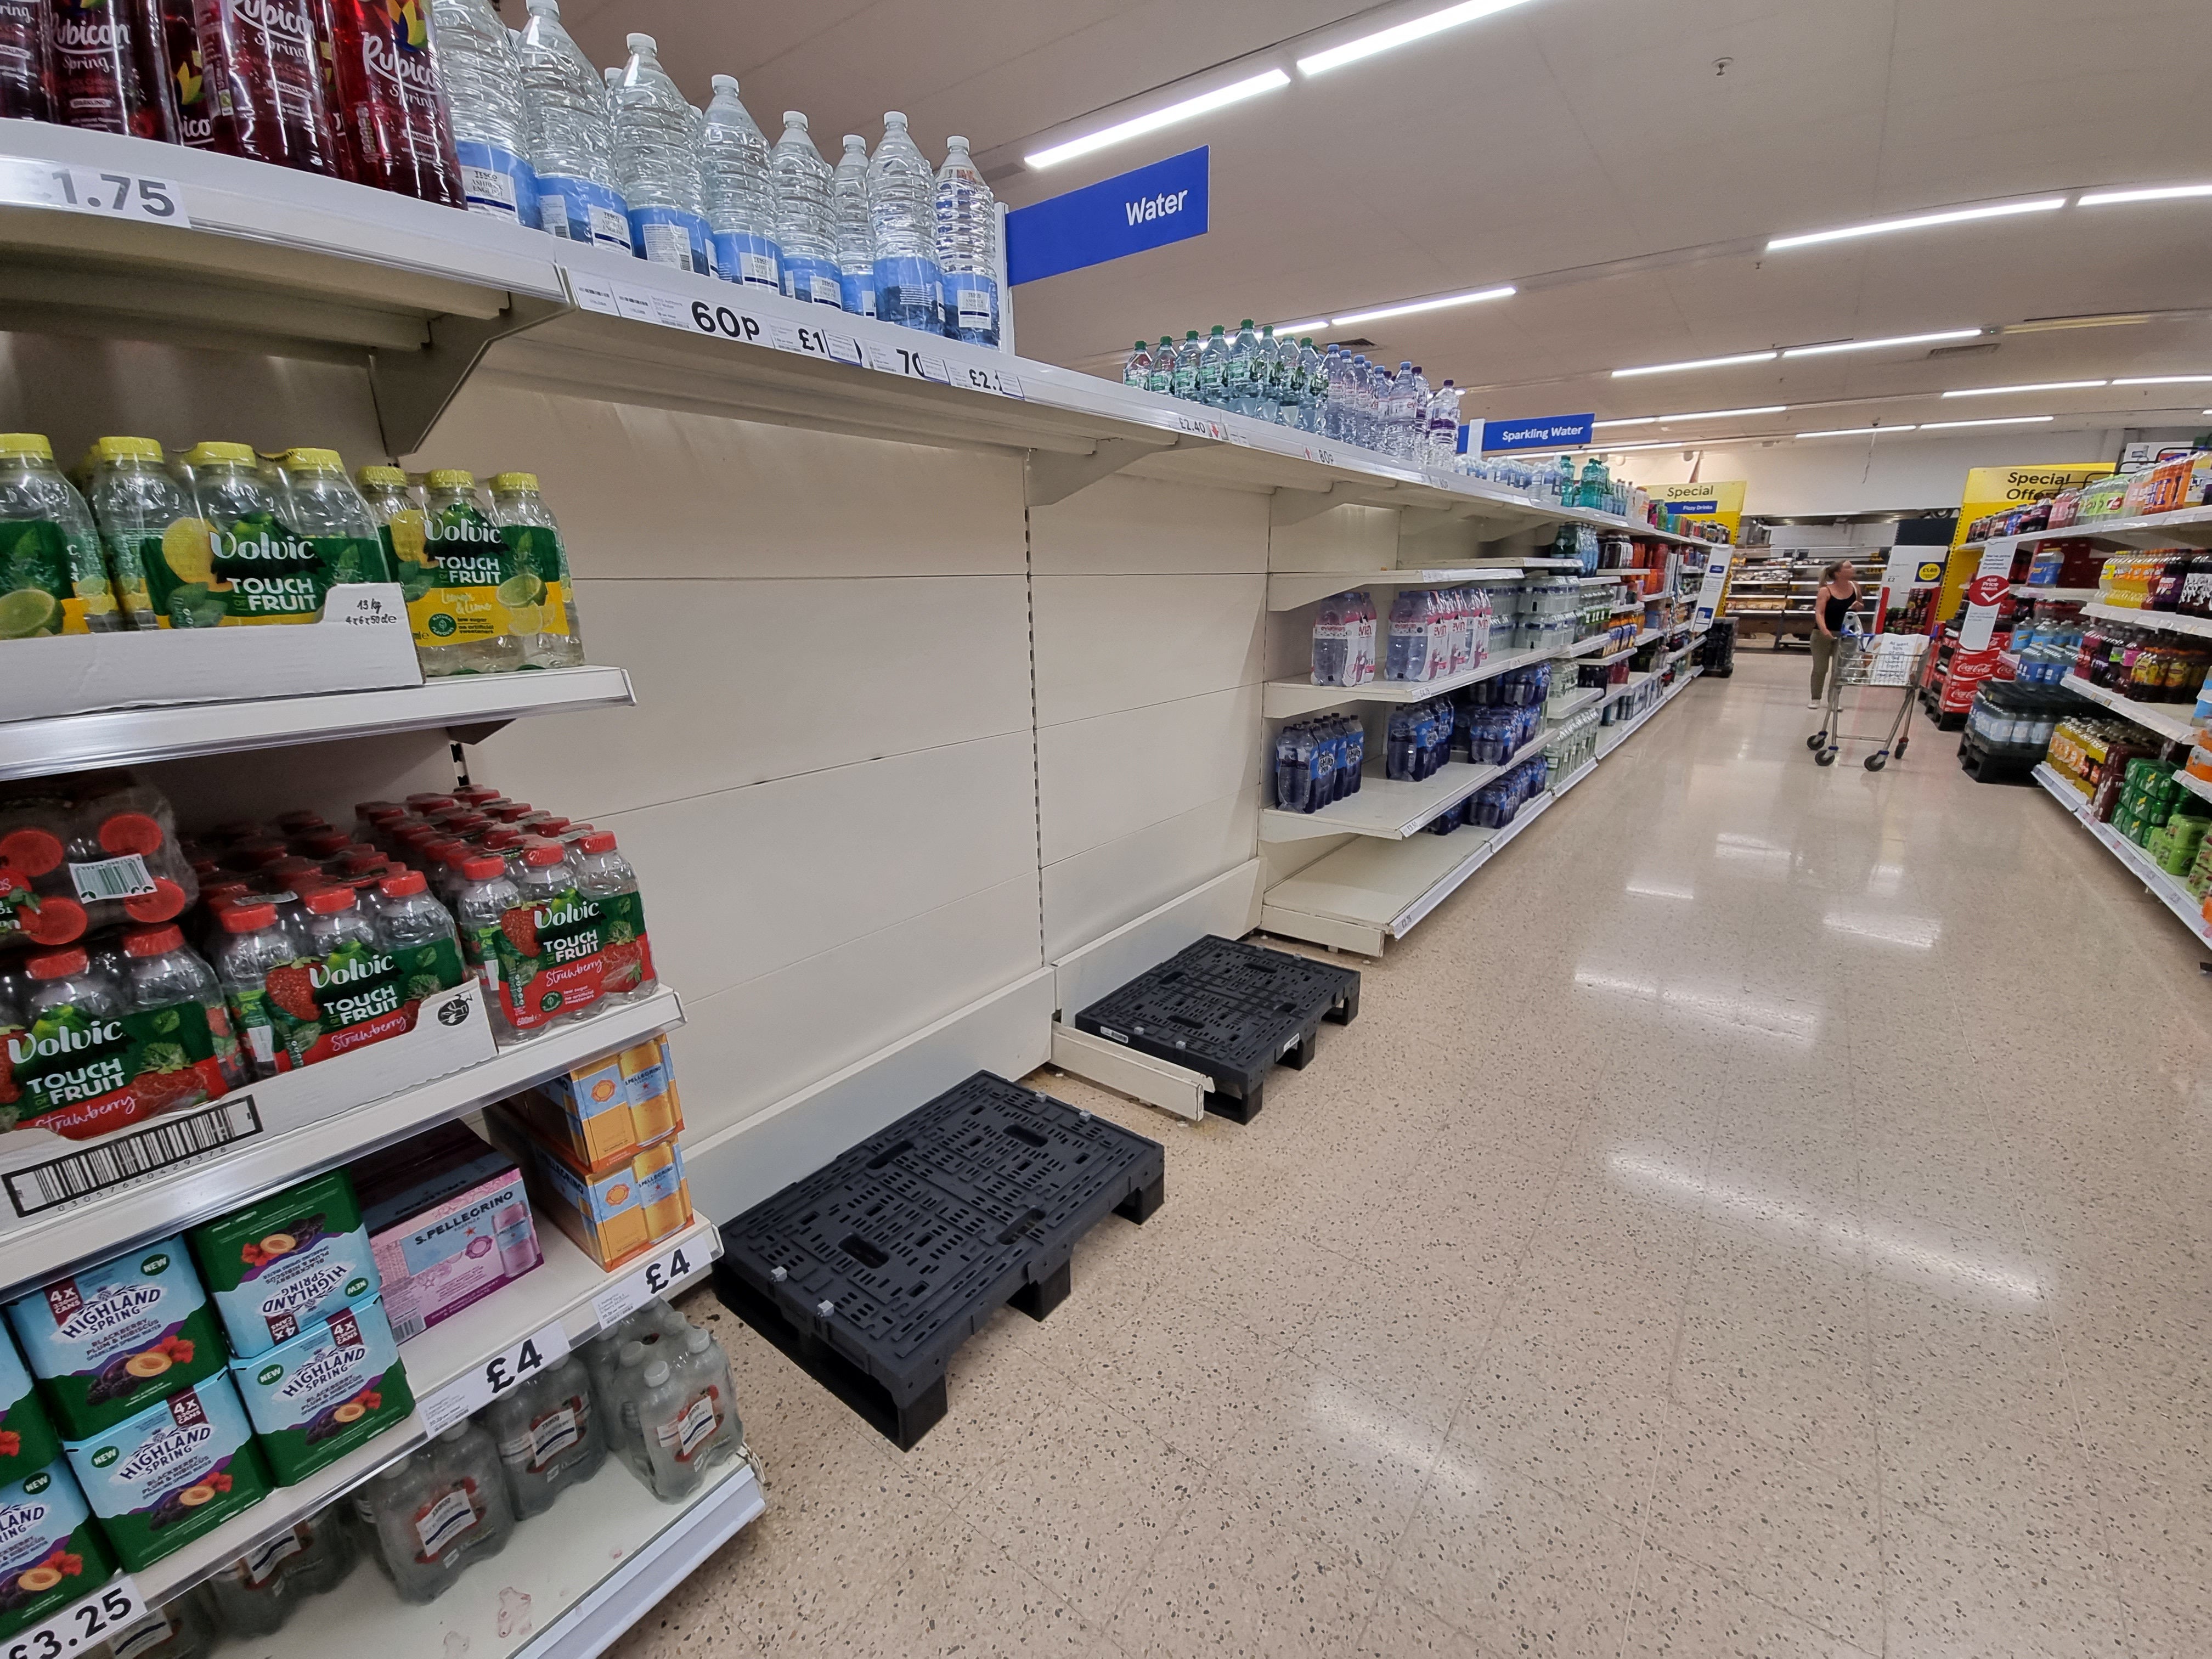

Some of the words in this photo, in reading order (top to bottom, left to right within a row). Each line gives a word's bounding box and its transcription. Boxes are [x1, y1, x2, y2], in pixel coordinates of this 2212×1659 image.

[55, 13, 131, 49] ubicon
[63, 56, 110, 75] Spring
[474, 170, 498, 182] TESCO
[33, 167, 175, 217] 1.75
[1126, 190, 1188, 226] Water
[691, 301, 760, 341] 60p
[1179, 417, 1206, 434] £2.40
[1502, 429, 1549, 443] Sparkling
[1551, 426, 1584, 437] Water
[1319, 449, 1334, 465] 80p
[1667, 485, 1714, 499] Special
[2007, 472, 2072, 487] Special
[424, 518, 502, 544] Volvic
[207, 531, 315, 560] Volvic
[438, 556, 500, 572] TOUCH
[450, 570, 501, 585] FRUIT
[226, 578, 312, 595] TOUCH
[249, 594, 317, 611] FRUIT
[357, 600, 369, 610] 13
[371, 597, 382, 614] kg
[534, 901, 600, 929] Volvic
[544, 930, 597, 953] TOUCH
[556, 940, 599, 963] FRUIT
[309, 955, 394, 989] Volvic
[546, 958, 603, 988] Strawberry
[323, 985, 396, 1015] TOUCH
[341, 996, 398, 1025] FRUIT
[8, 1020, 124, 1064] Volvic
[331, 1015, 408, 1052] Strawberry
[27, 1058, 122, 1094] TOUCH
[49, 1072, 125, 1105] FRUIT
[415, 1191, 513, 1245] S.PELLEGRINO
[143, 1257, 167, 1273] NEW
[645, 1249, 691, 1295] £4
[263, 1265, 347, 1313] HIGHLAND
[281, 1269, 325, 1296] SPRING
[347, 1280, 367, 1295] NEW
[55, 1300, 81, 1314] CANS
[61, 1289, 161, 1339] HIGHLAND
[90, 1306, 140, 1335] SPRING
[92, 1318, 147, 1347] BLACKBERRY
[270, 1316, 292, 1329] CANS
[86, 1342, 111, 1356] PLUM
[120, 1319, 159, 1340] HIBISCUS
[337, 1331, 358, 1345] CANS
[259, 1367, 281, 1383] NEW
[283, 1348, 365, 1397] HIGHLAND
[306, 1364, 348, 1392] SPRING
[486, 1339, 544, 1393] £4
[178, 1410, 201, 1424] CANS
[93, 1448, 117, 1465] NEW
[119, 1427, 211, 1480] HIGHLAND
[145, 1445, 192, 1475] SPRING
[25, 1476, 48, 1492] NEW
[147, 1455, 198, 1486] BLACKBERRY
